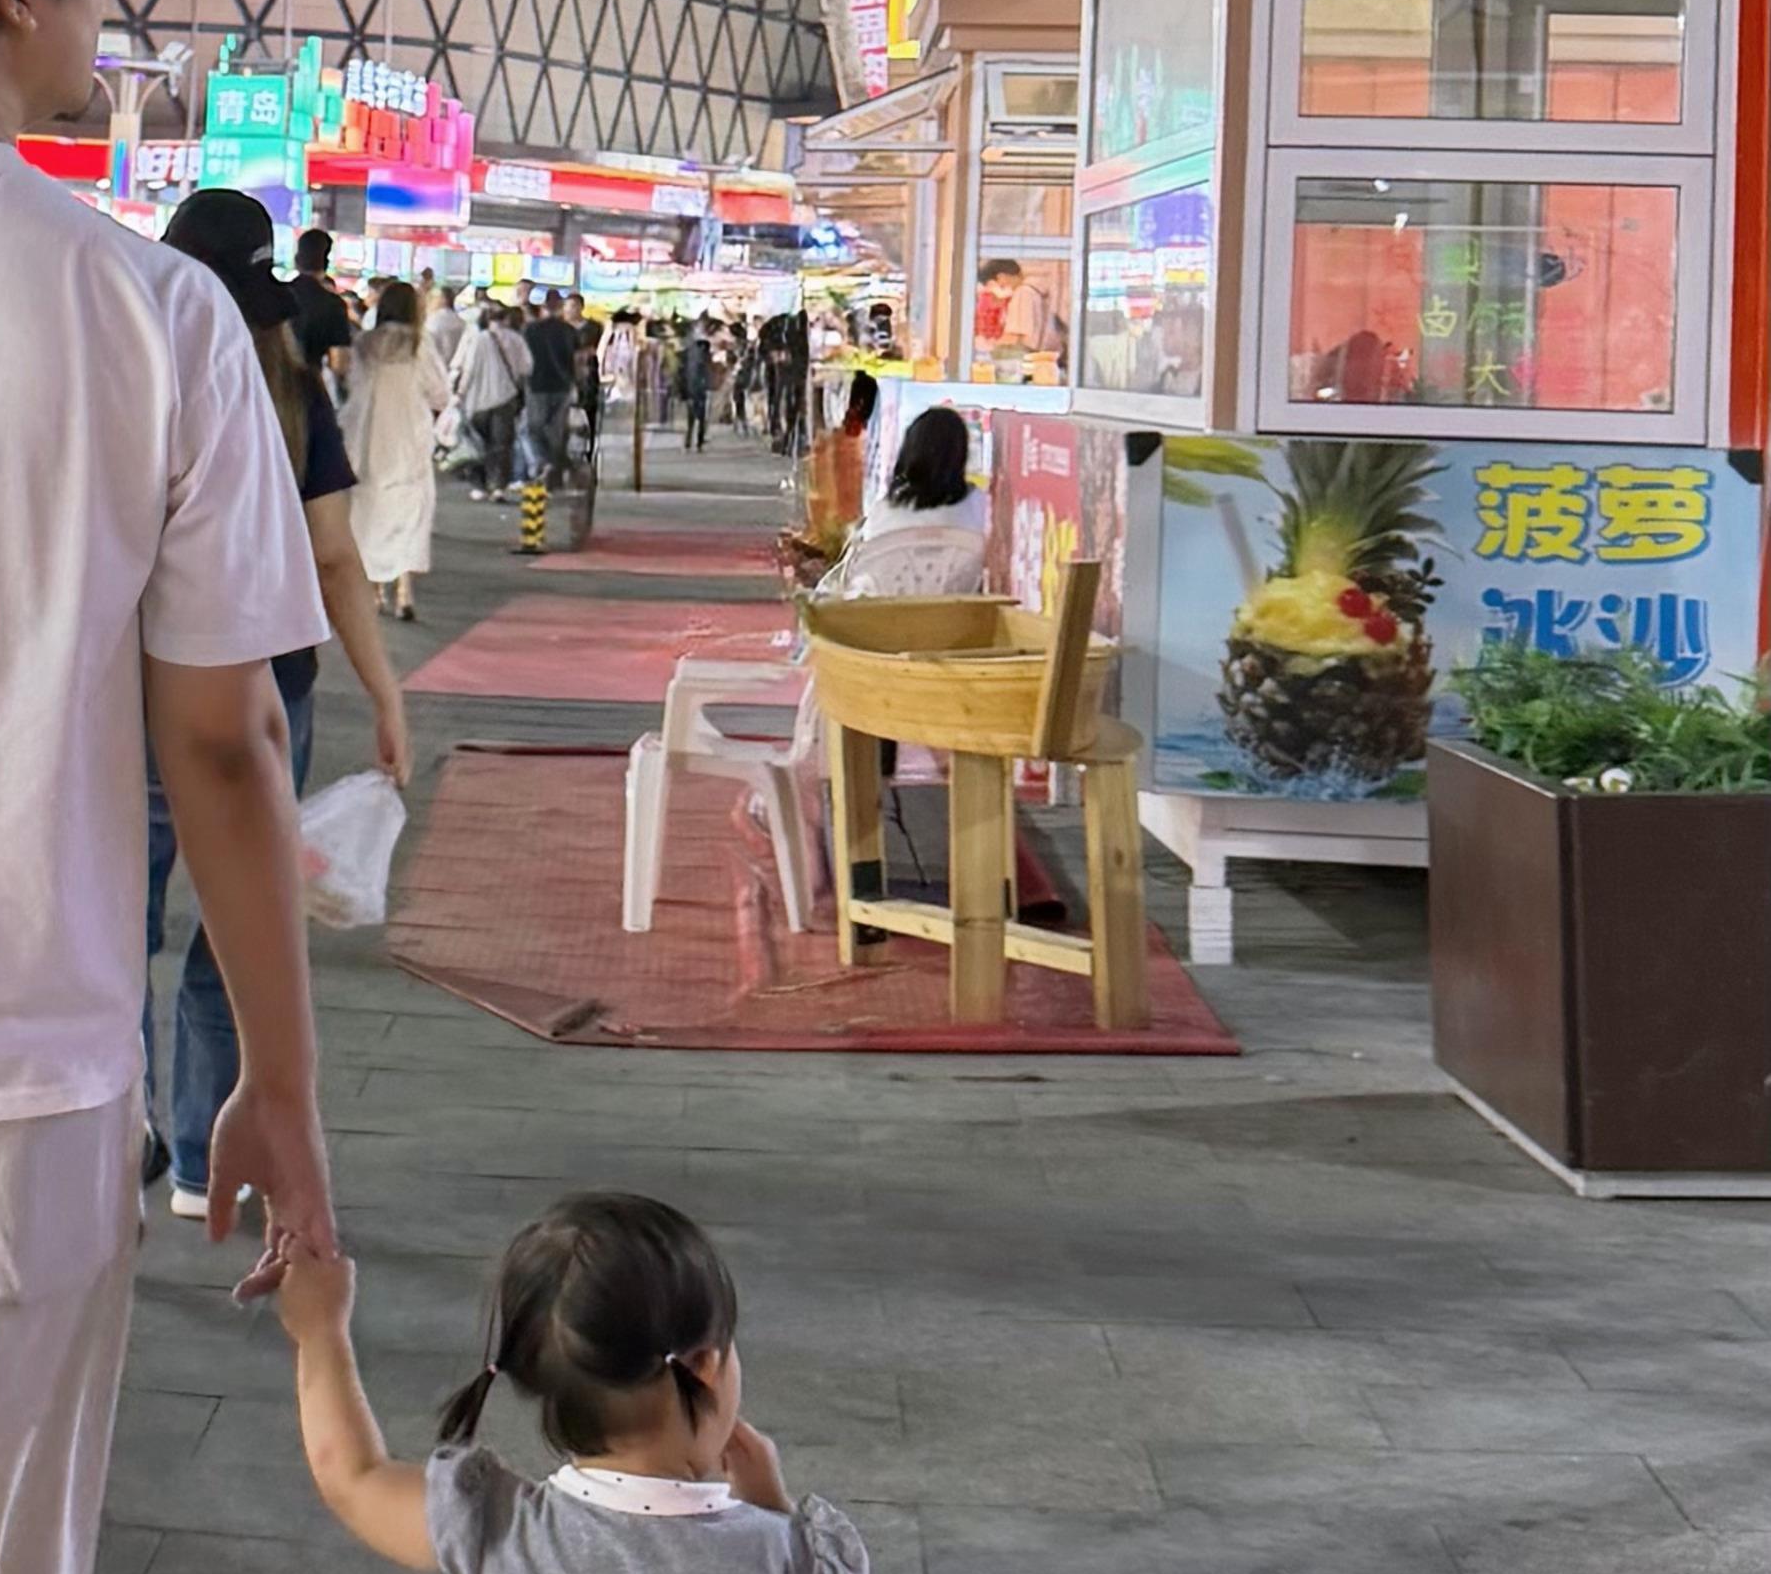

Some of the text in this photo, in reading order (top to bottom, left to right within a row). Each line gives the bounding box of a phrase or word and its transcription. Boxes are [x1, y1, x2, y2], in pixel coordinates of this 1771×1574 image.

[217, 89, 279, 126] 青岛
[1476, 460, 1716, 565] 菠萝
[1480, 585, 1714, 689] 冰沙
